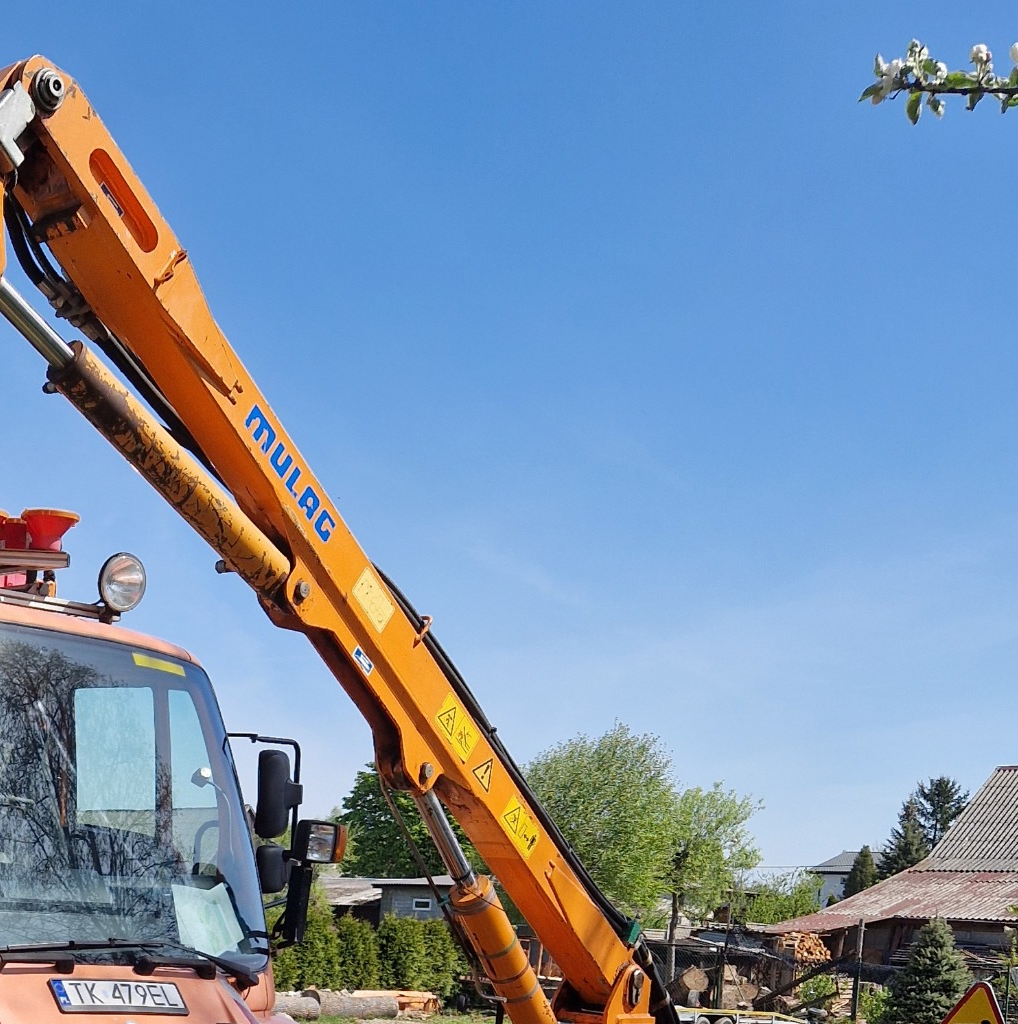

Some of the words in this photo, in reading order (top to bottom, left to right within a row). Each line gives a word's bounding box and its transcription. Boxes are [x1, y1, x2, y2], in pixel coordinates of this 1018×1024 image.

[244, 404, 336, 543] MULAG
[68, 982, 104, 1005] TK
[112, 983, 179, 1007] 479EL
